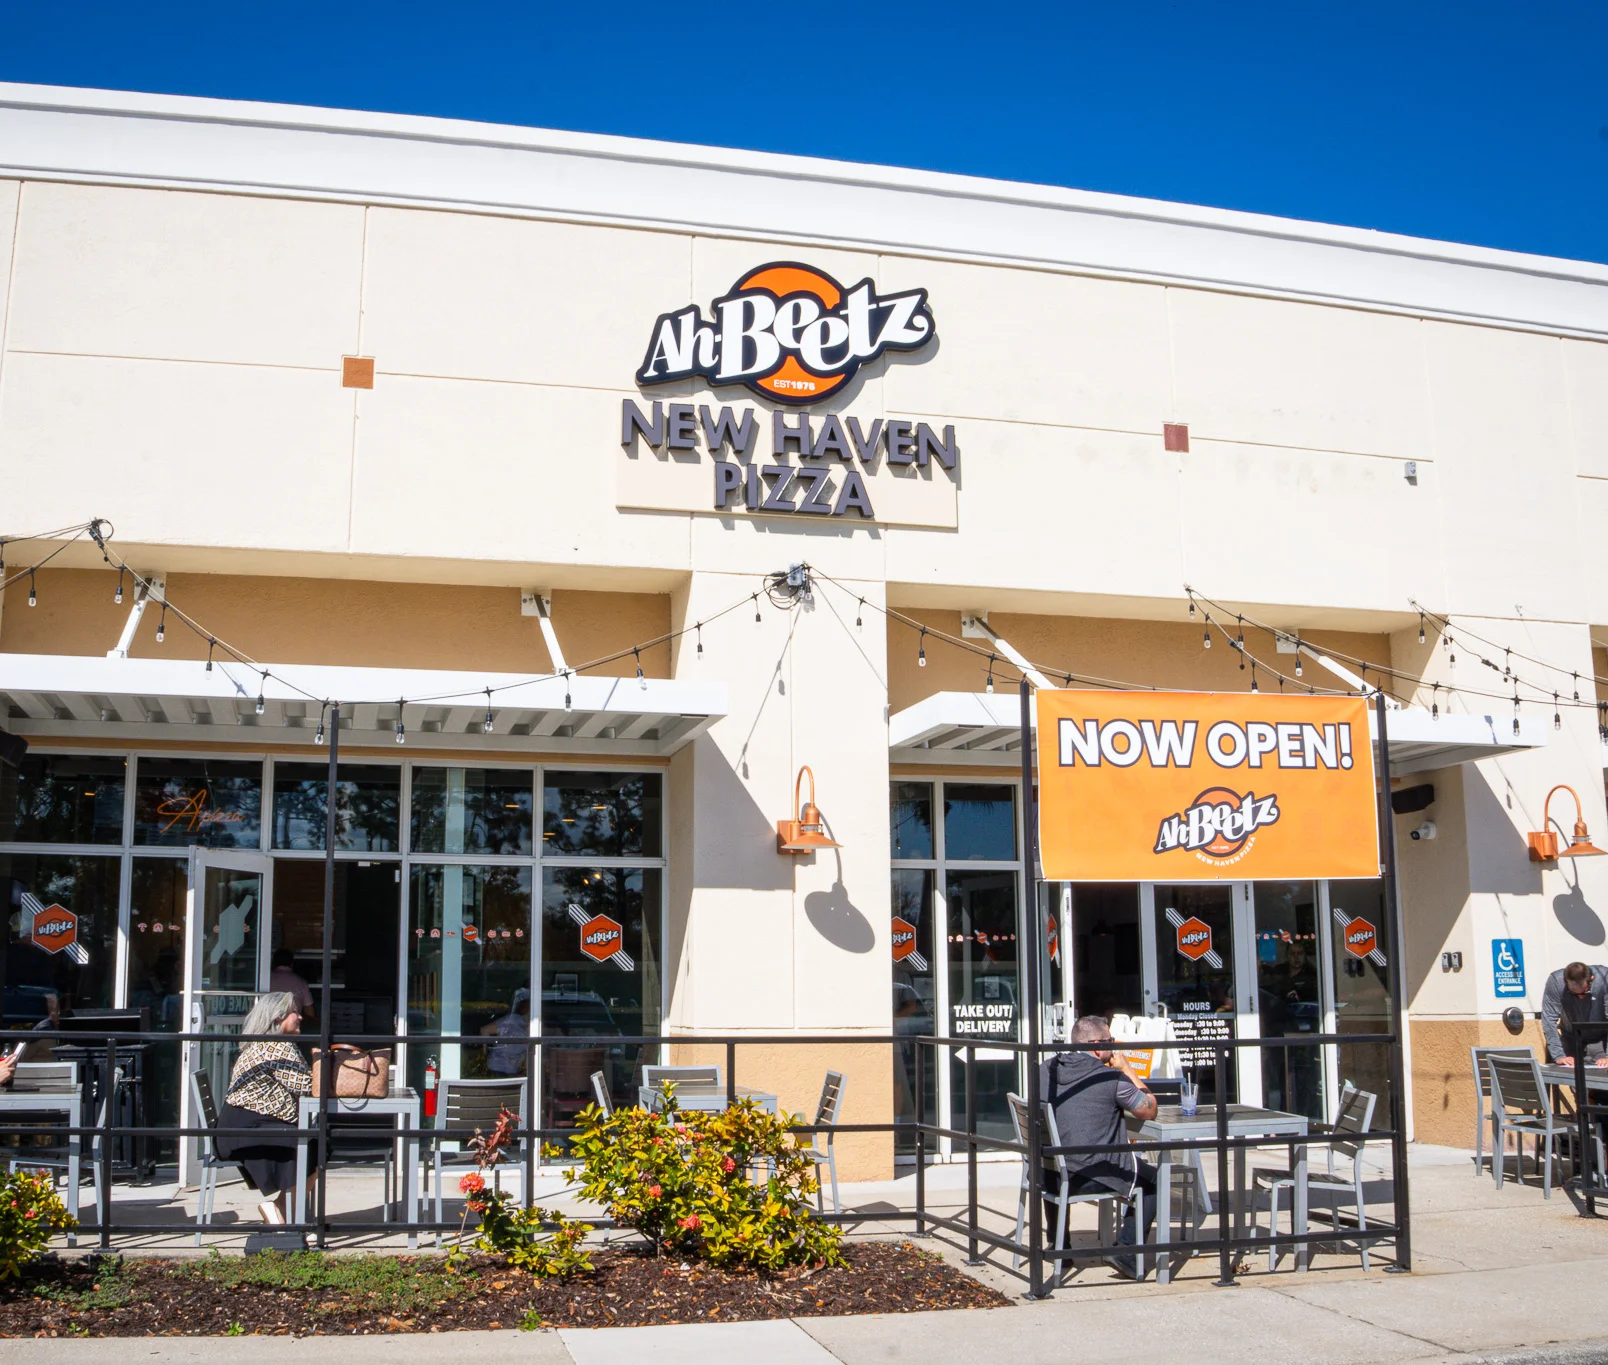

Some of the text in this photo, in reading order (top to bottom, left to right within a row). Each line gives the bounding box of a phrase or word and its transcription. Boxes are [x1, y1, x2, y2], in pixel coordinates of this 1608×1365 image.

[620, 398, 956, 469] NEW HAVEN
[714, 461, 875, 518] PIZZA
[1057, 717, 1354, 770] NOW OPEN!
[1195, 852, 1214, 865] NEW
[1214, 856, 1241, 867] HAVEN
[1240, 836, 1257, 858] PIZZA
[1497, 977, 1522, 985] ENTRANCE
[953, 1004, 984, 1018] TAKE
[1183, 1002, 1211, 1011] HOURS
[955, 1020, 1011, 1033] DELIVERY
